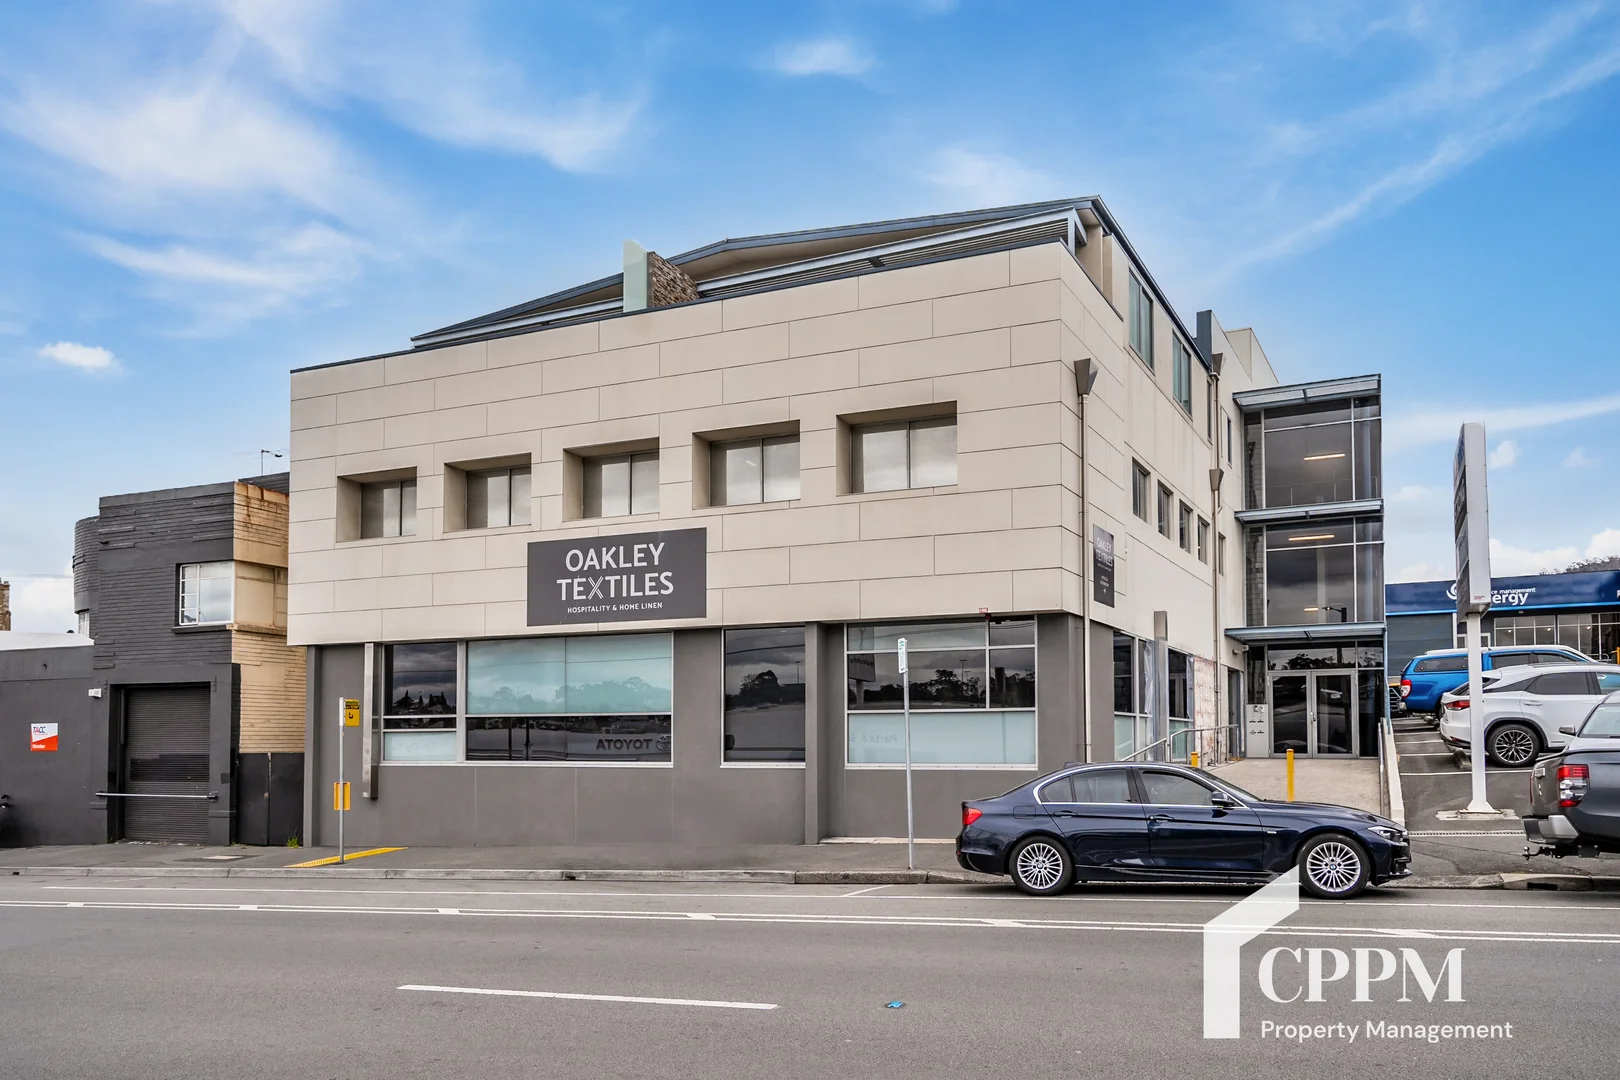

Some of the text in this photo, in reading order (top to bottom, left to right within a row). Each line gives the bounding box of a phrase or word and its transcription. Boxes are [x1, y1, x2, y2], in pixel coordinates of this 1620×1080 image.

[565, 542, 665, 572] OAKLEY
[556, 571, 674, 601] TEXTILES
[567, 605, 611, 614] HOSPITALITY
[619, 603, 639, 611] HOME
[1491, 593, 1529, 606] ergy
